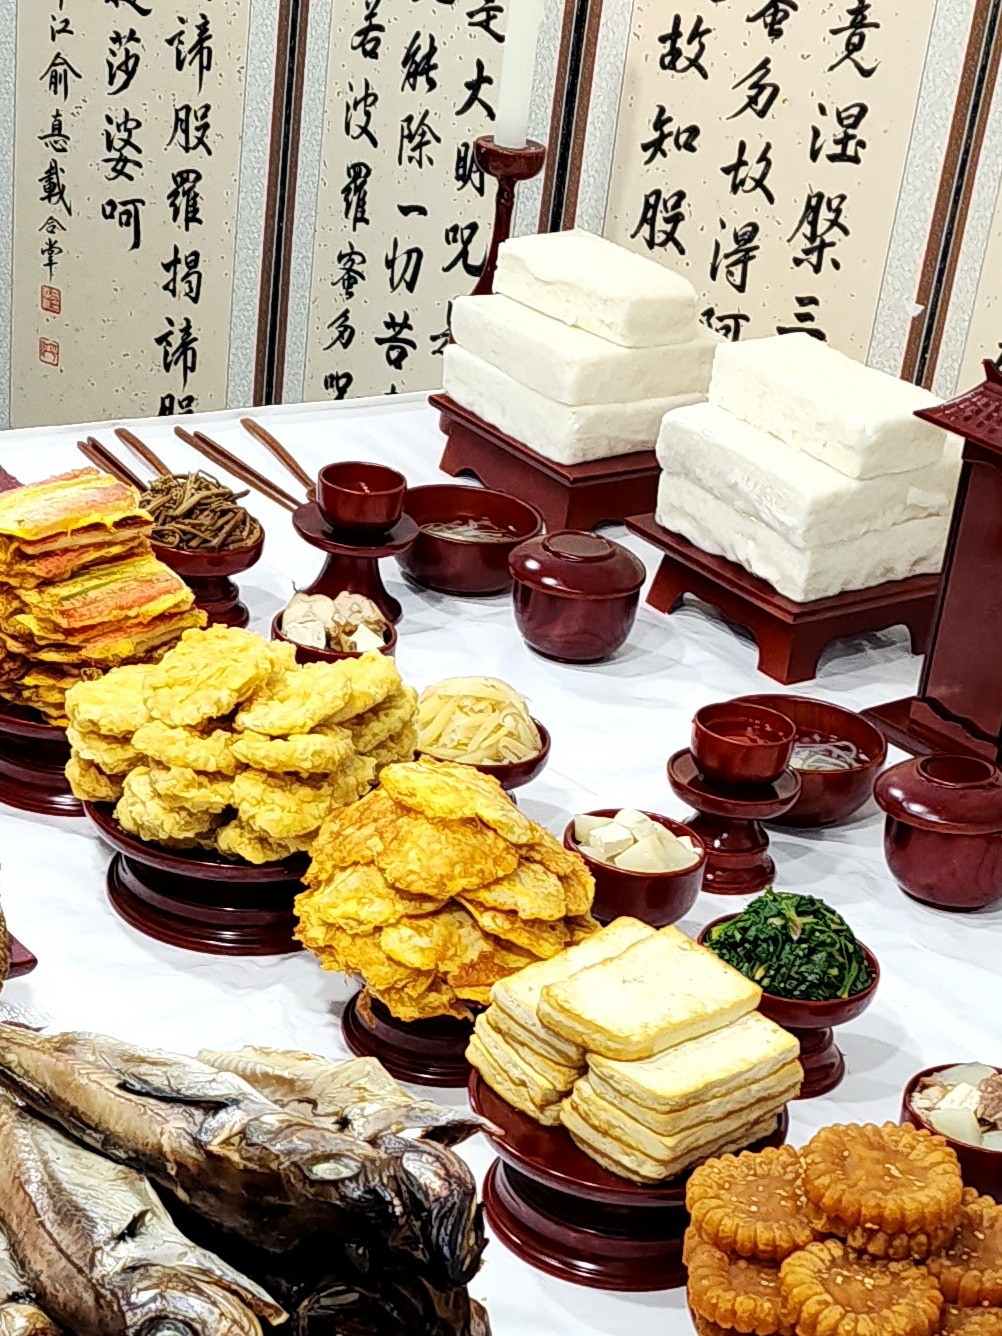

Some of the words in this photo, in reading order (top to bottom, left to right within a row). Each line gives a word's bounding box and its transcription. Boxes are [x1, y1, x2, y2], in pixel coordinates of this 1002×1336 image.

[101, 0, 152, 251] 莎婆呵
[374, 31, 442, 395] 能除一切苦
